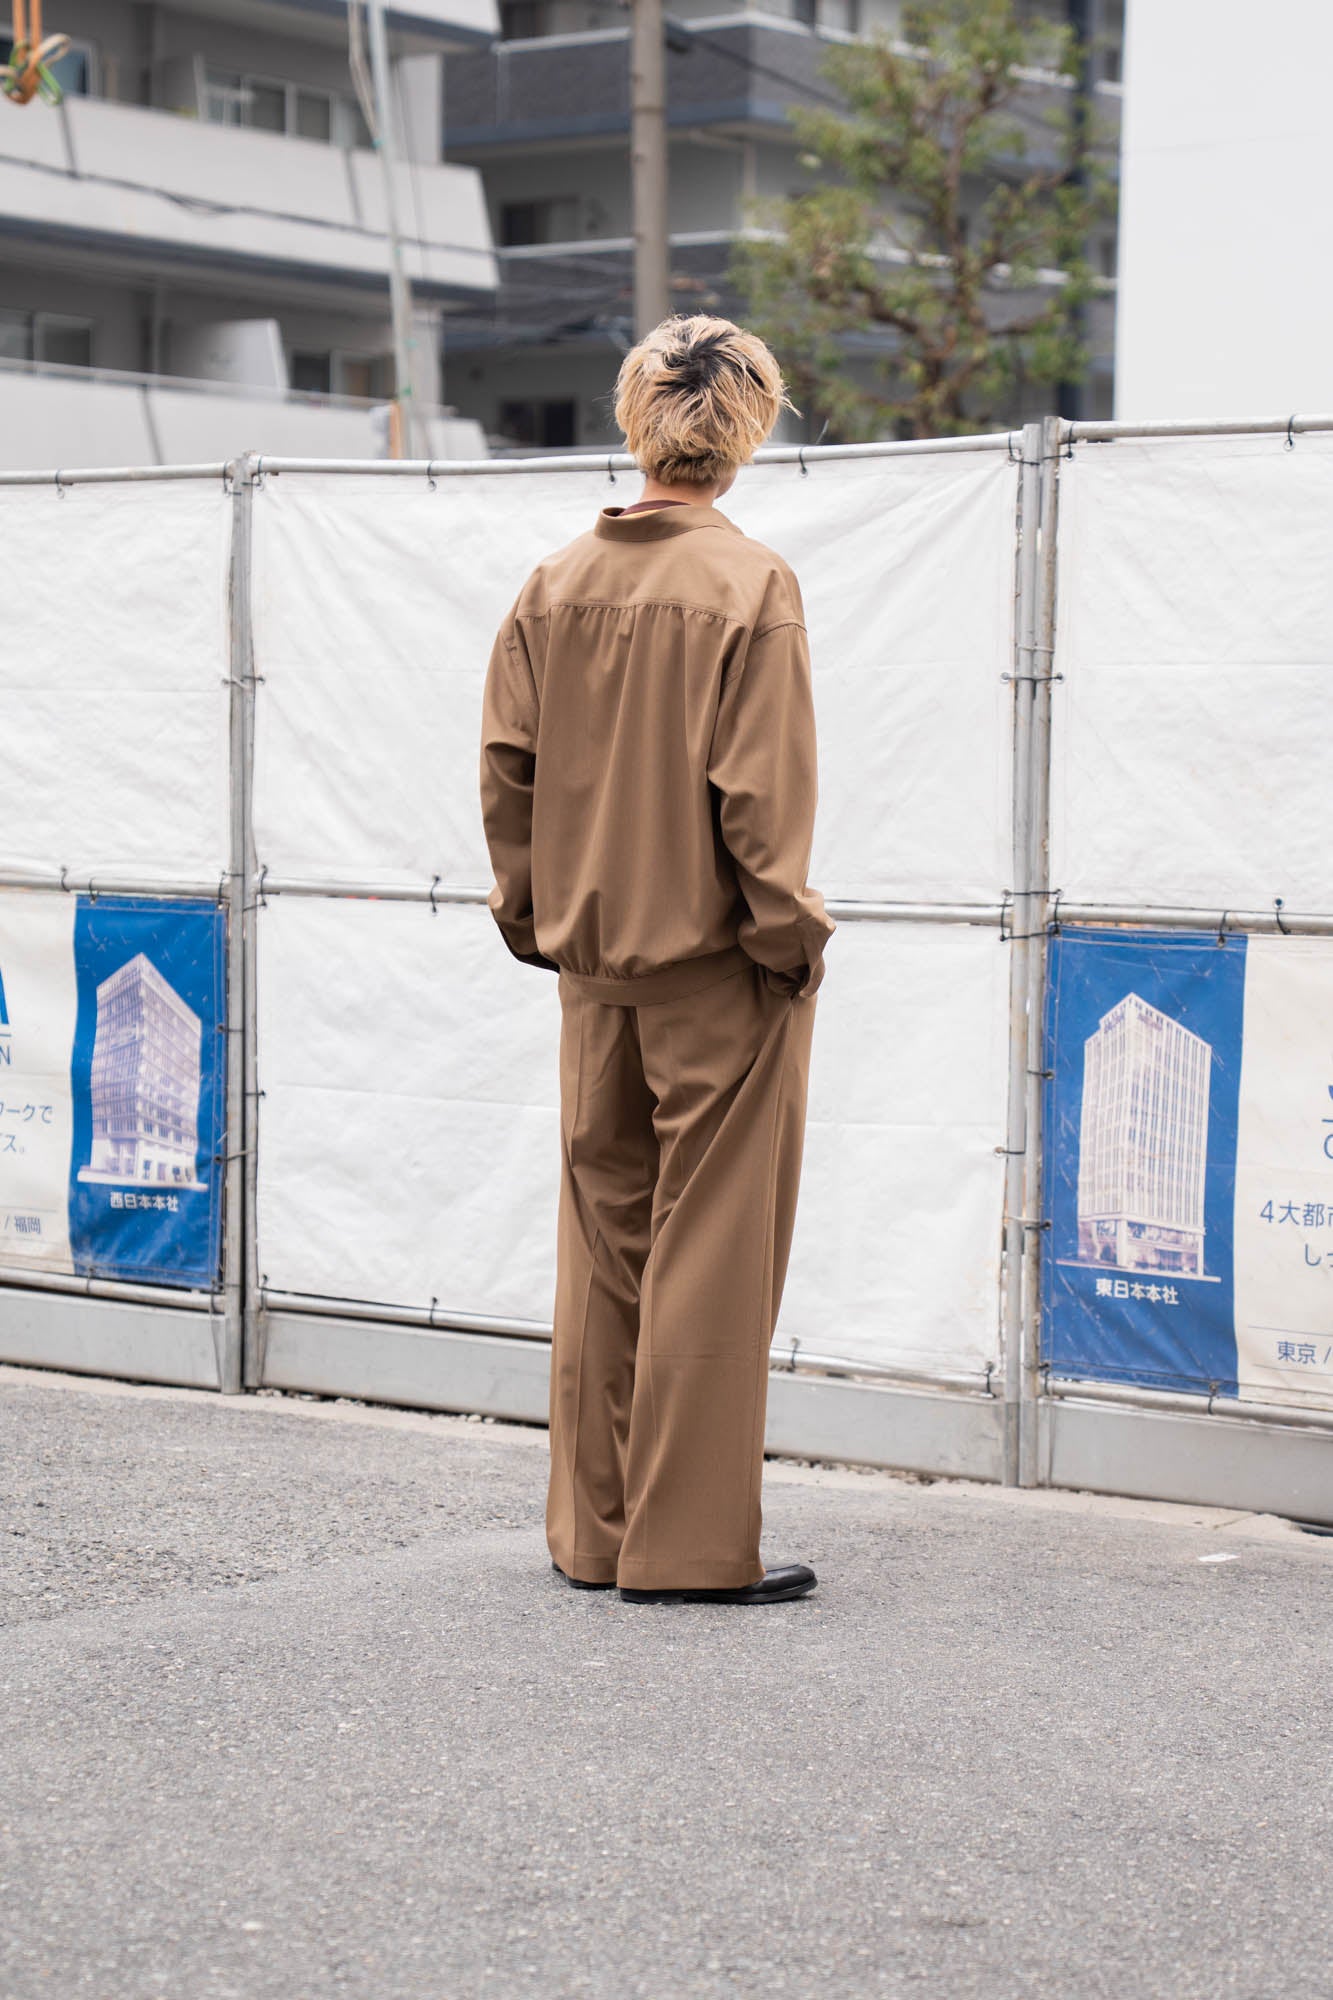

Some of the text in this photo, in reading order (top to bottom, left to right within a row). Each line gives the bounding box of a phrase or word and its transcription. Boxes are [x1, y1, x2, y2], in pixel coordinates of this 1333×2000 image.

[0, 1132, 25, 1154] ス。
[1095, 1278, 1179, 1305] 東日本本社
